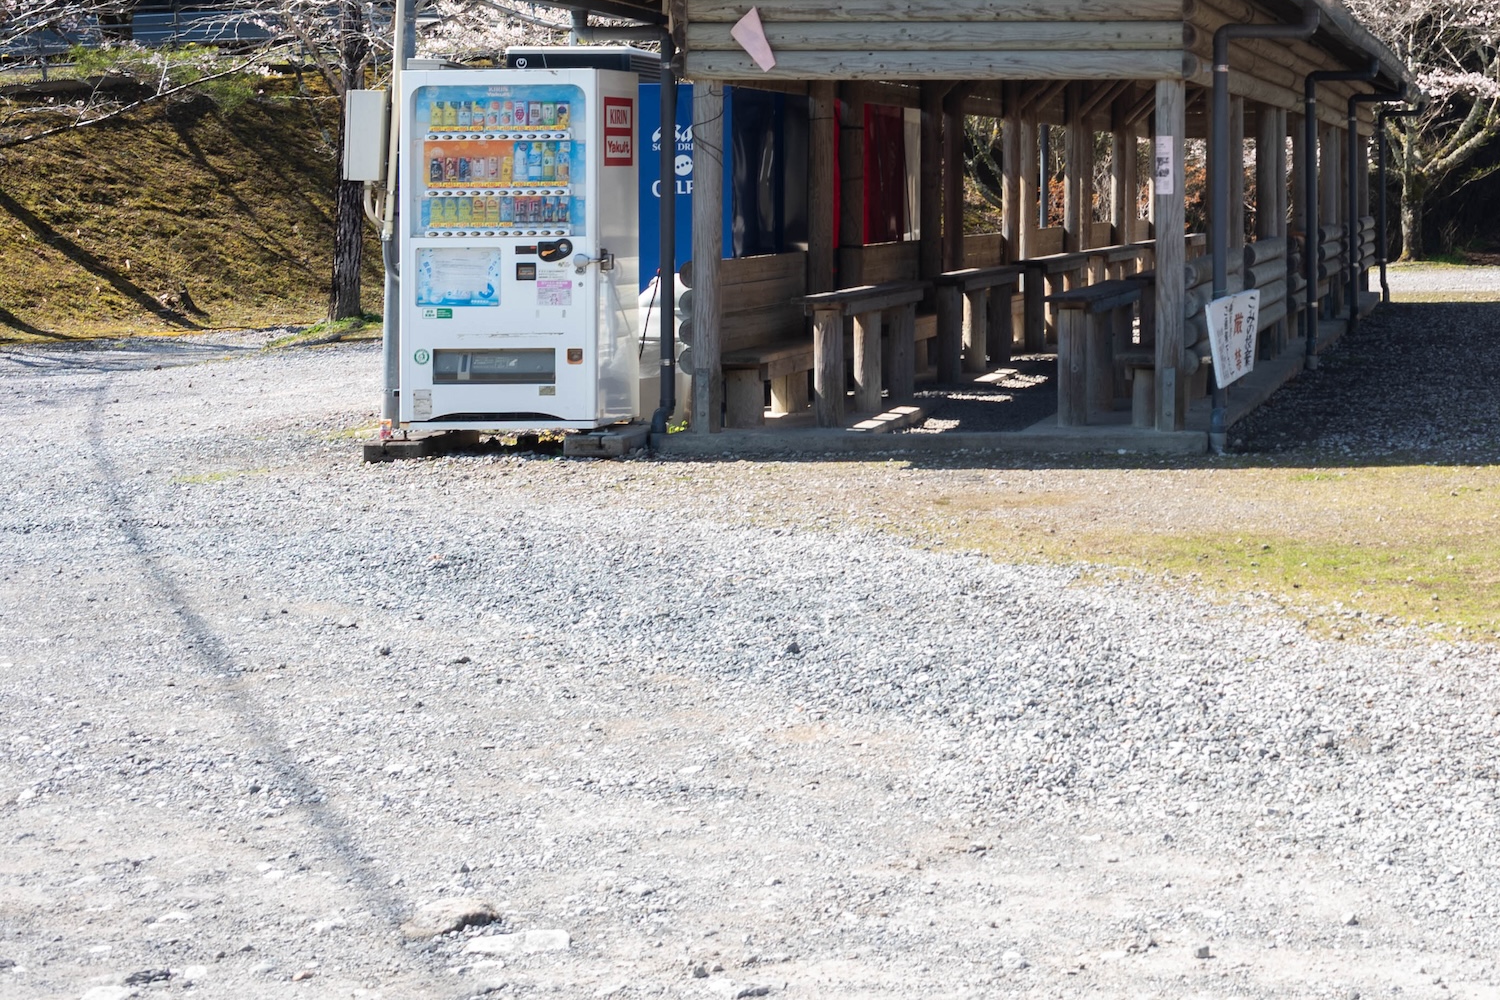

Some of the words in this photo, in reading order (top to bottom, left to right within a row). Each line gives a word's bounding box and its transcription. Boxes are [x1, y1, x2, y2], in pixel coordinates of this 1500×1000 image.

[610, 109, 628, 125] KIRIN
[607, 140, 631, 154] Yakult
[1233, 312, 1244, 372] 厳禁
